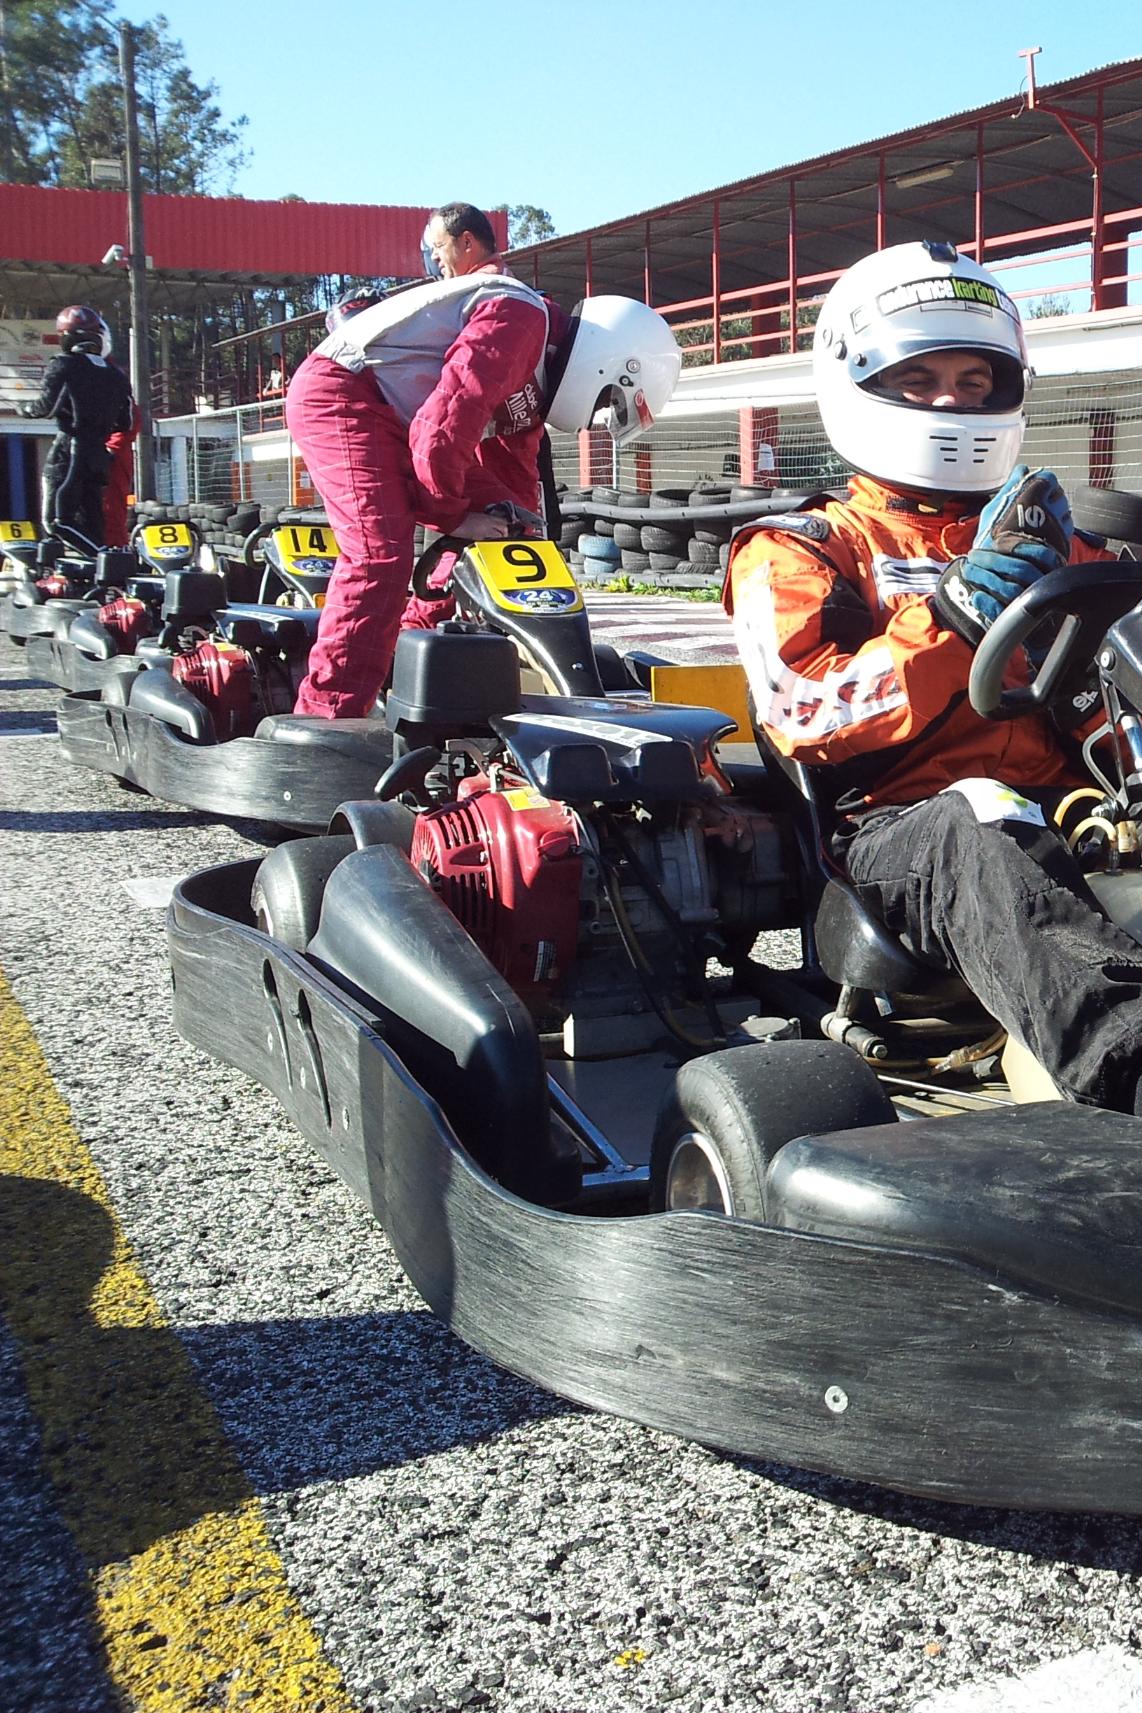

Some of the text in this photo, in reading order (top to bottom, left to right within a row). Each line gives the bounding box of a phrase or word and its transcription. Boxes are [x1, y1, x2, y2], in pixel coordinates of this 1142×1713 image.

[10, 523, 22, 538] 6
[159, 525, 178, 543] 8
[290, 528, 327, 553] 14
[502, 543, 547, 583] 9
[523, 590, 554, 602] 24
